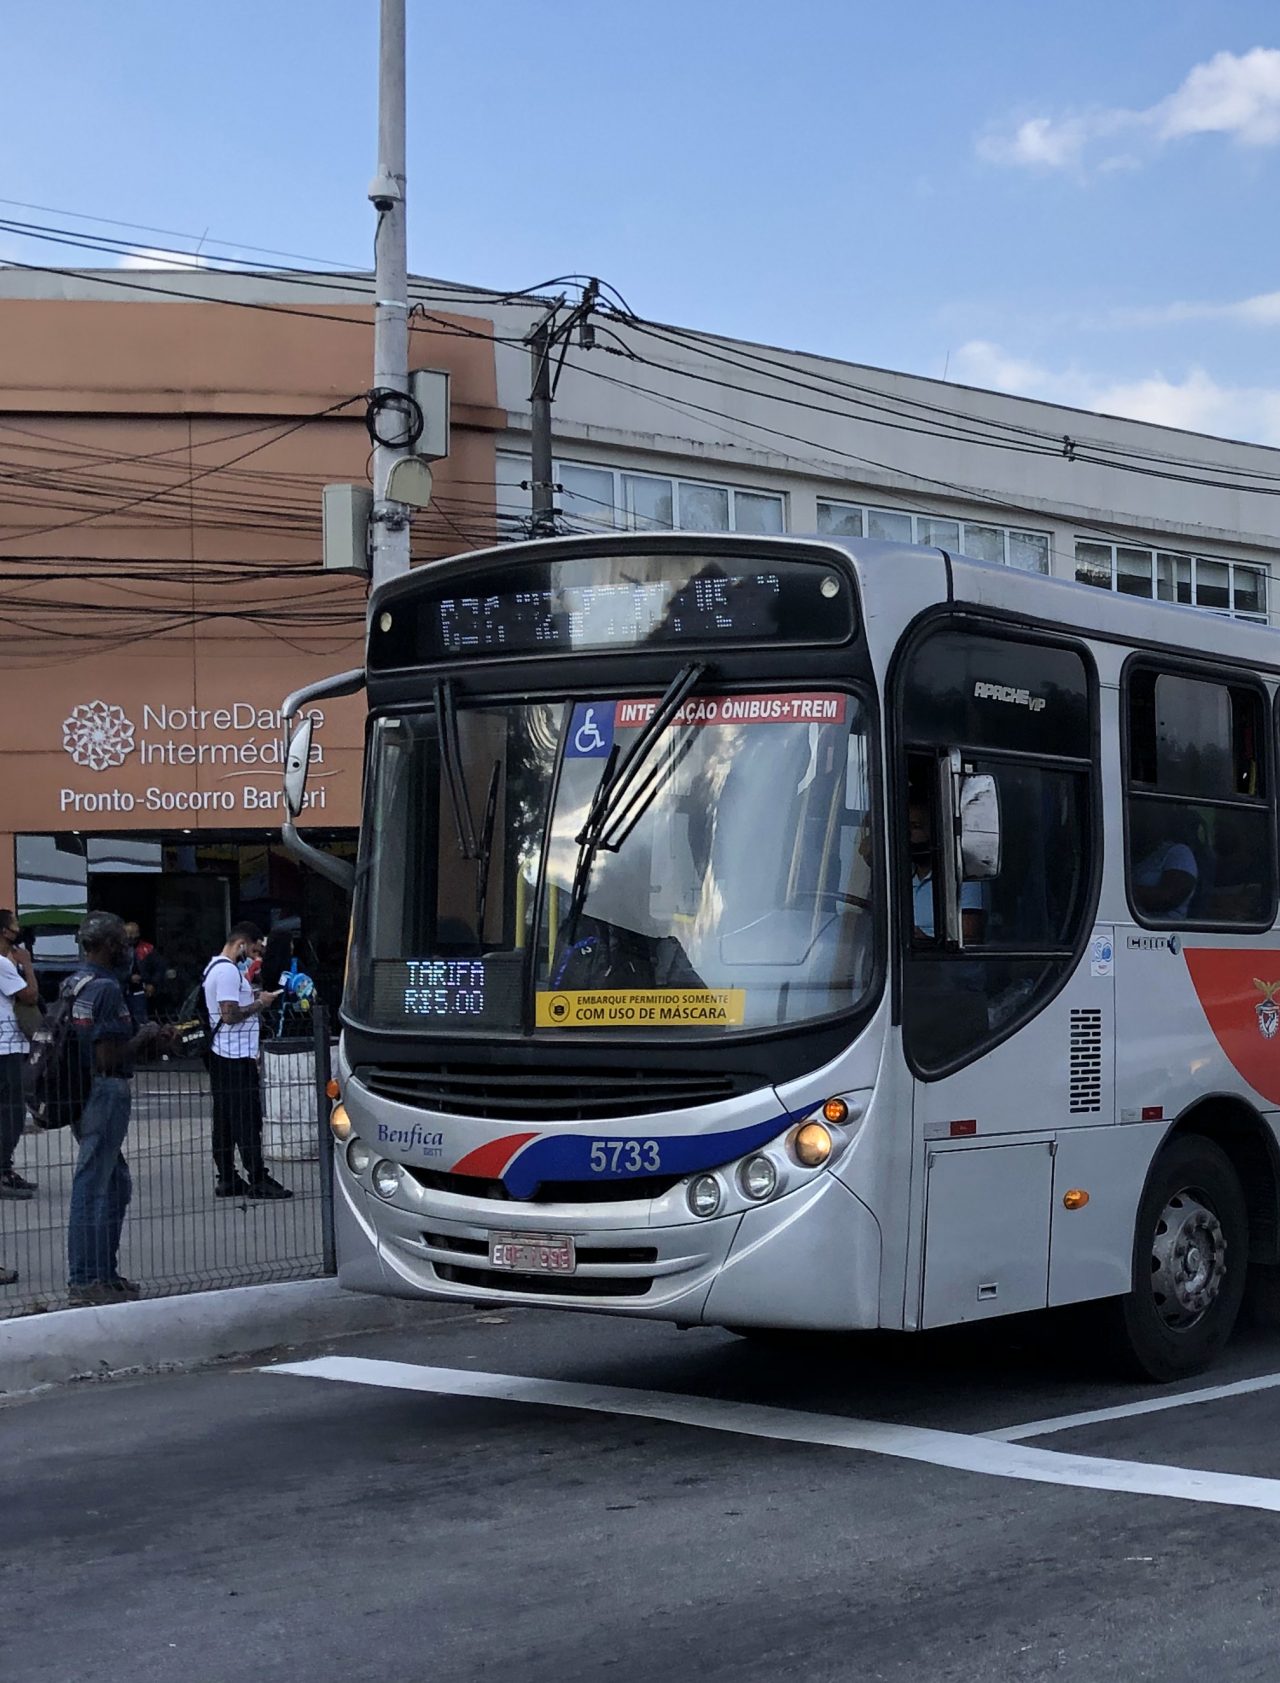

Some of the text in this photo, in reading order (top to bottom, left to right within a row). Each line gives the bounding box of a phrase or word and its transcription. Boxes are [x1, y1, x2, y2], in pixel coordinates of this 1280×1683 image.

[974, 681, 1046, 712] APACHE VIP
[621, 698, 838, 725] INTEAÇÃO ÔNIBUS+TREM
[140, 737, 324, 765] Intermédia
[60, 786, 325, 812] Pronto-Socorro Bareri
[406, 961, 484, 986] TARIFA
[576, 1005, 727, 1020] COM USO DE MÁSCARA
[577, 994, 729, 1005] EMBARQUE PERMITIDO SOMENTE
[378, 1123, 443, 1152] Benfica
[590, 1140, 661, 1172] 5733
